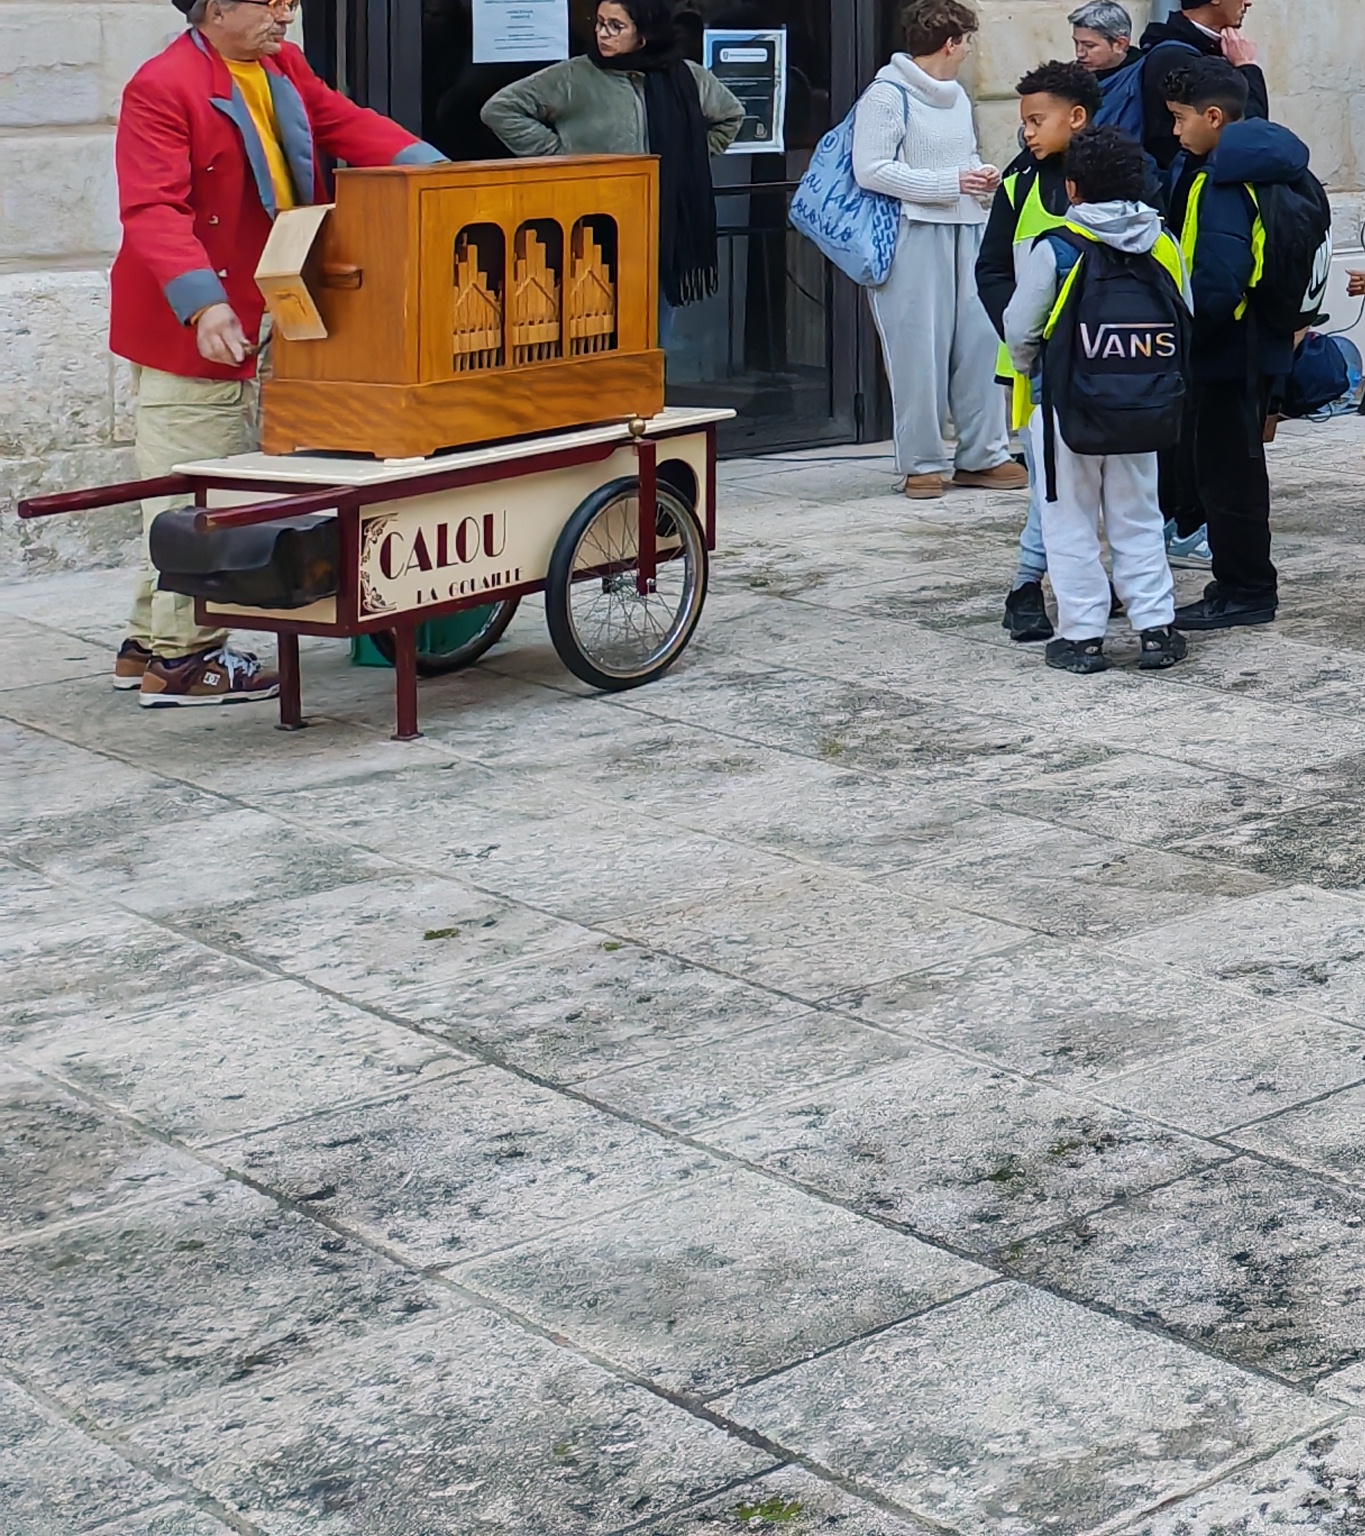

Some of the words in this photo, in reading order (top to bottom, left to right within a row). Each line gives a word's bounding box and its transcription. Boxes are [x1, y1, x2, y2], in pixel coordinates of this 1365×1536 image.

[1079, 322, 1176, 359] VANS
[379, 509, 507, 581] CALOU
[416, 586, 439, 605] LA
